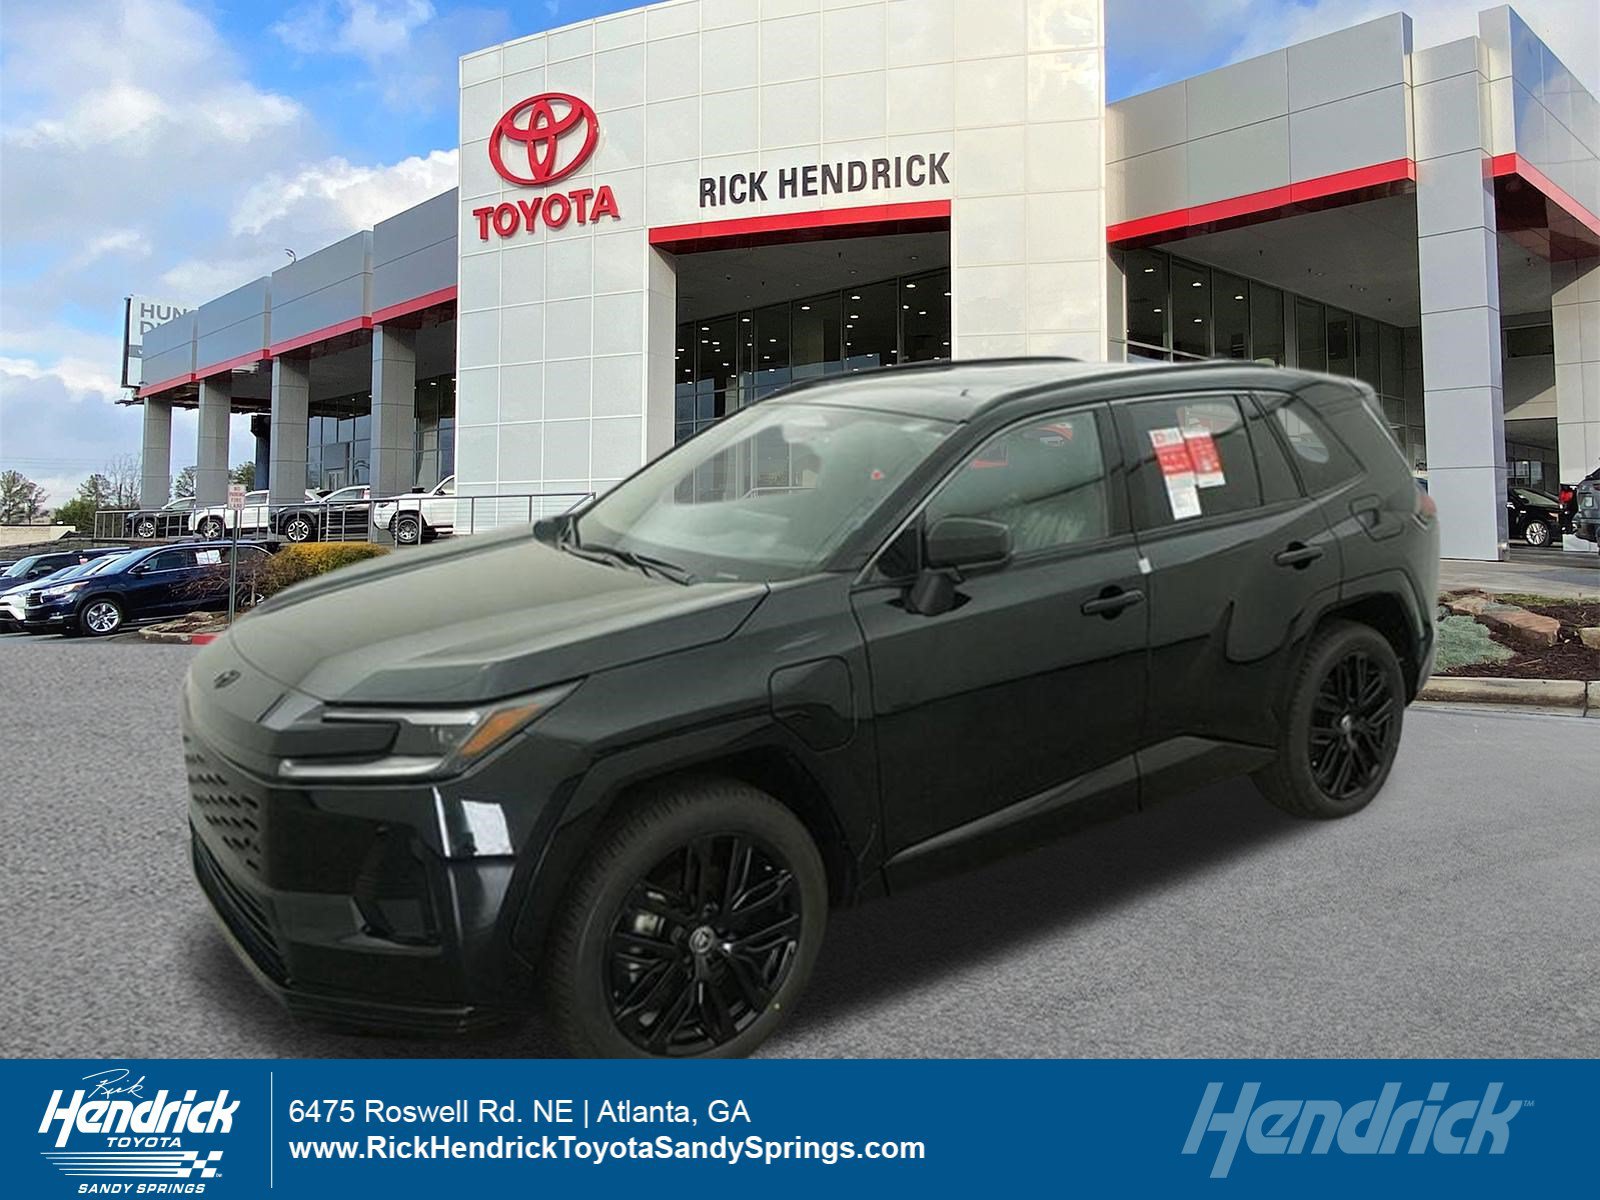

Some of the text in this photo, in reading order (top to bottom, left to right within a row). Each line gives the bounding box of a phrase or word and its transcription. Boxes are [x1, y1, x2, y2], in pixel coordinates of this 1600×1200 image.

[699, 152, 951, 208] RICK HENDRICK
[472, 185, 621, 241] TOYOTA
